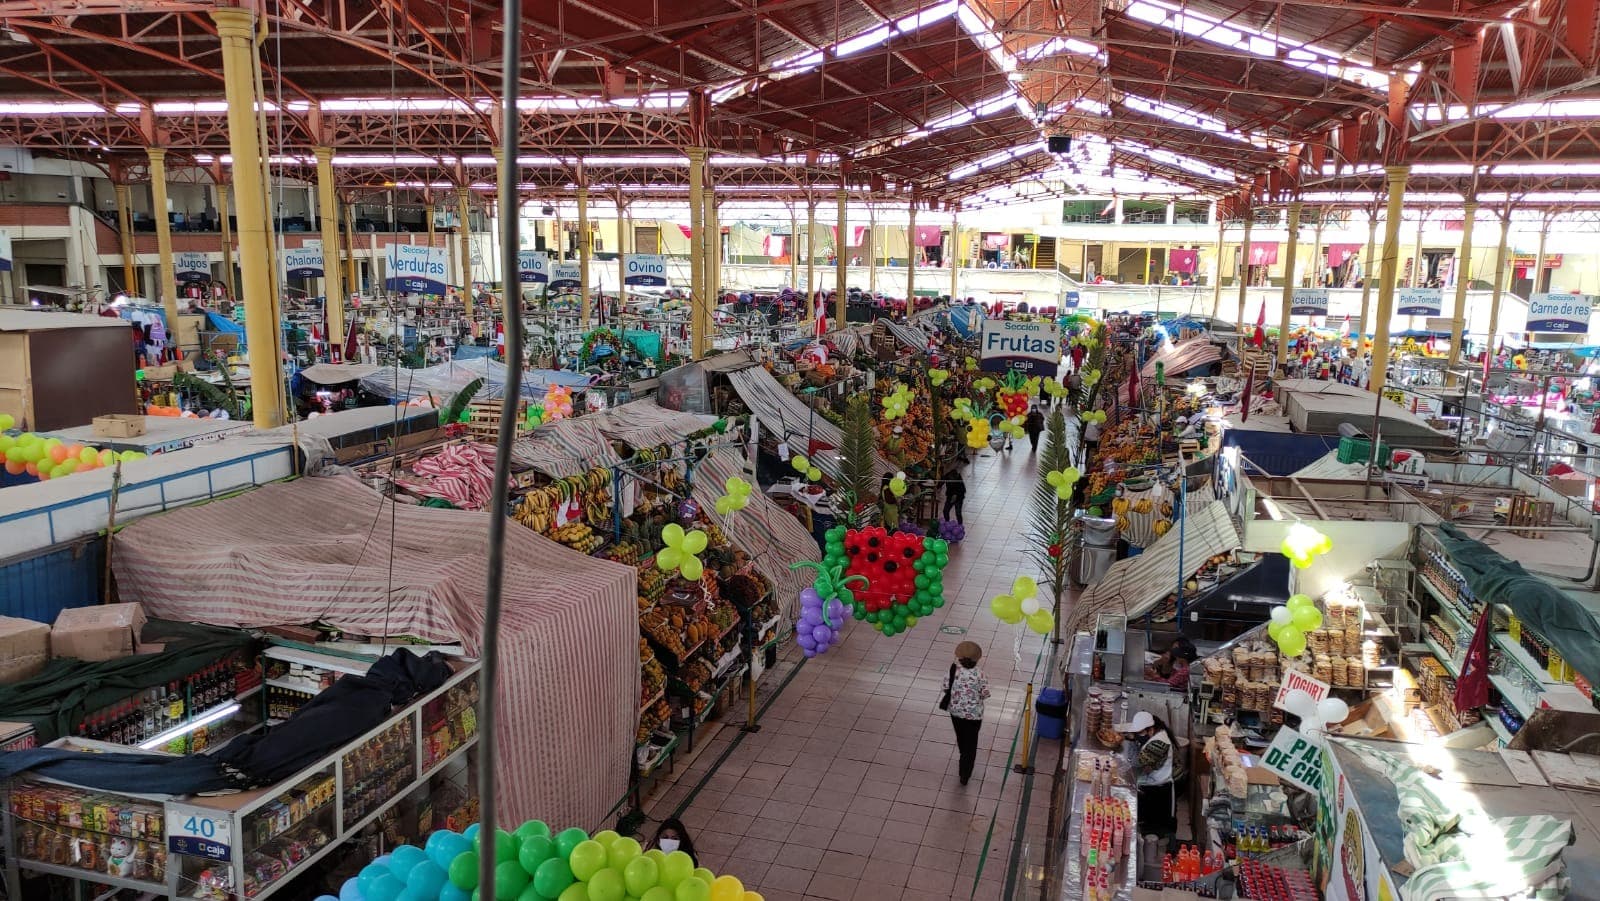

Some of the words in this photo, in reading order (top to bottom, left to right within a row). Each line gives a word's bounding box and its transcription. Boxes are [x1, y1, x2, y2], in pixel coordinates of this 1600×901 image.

[178, 256, 208, 270] Jugos
[286, 255, 322, 267] Chalona
[388, 255, 445, 275] Verduras
[628, 260, 663, 273] Ovino
[1531, 301, 1559, 314] Carne
[1560, 302, 1572, 315] de
[1574, 306, 1590, 316] res
[1004, 322, 1040, 331] Sección
[987, 332, 1055, 354] Frutas
[1014, 360, 1034, 370] caja
[1286, 672, 1325, 703] YOGURT
[1265, 747, 1292, 772] DE
[183, 816, 215, 838] 40
[206, 845, 225, 856] caja
